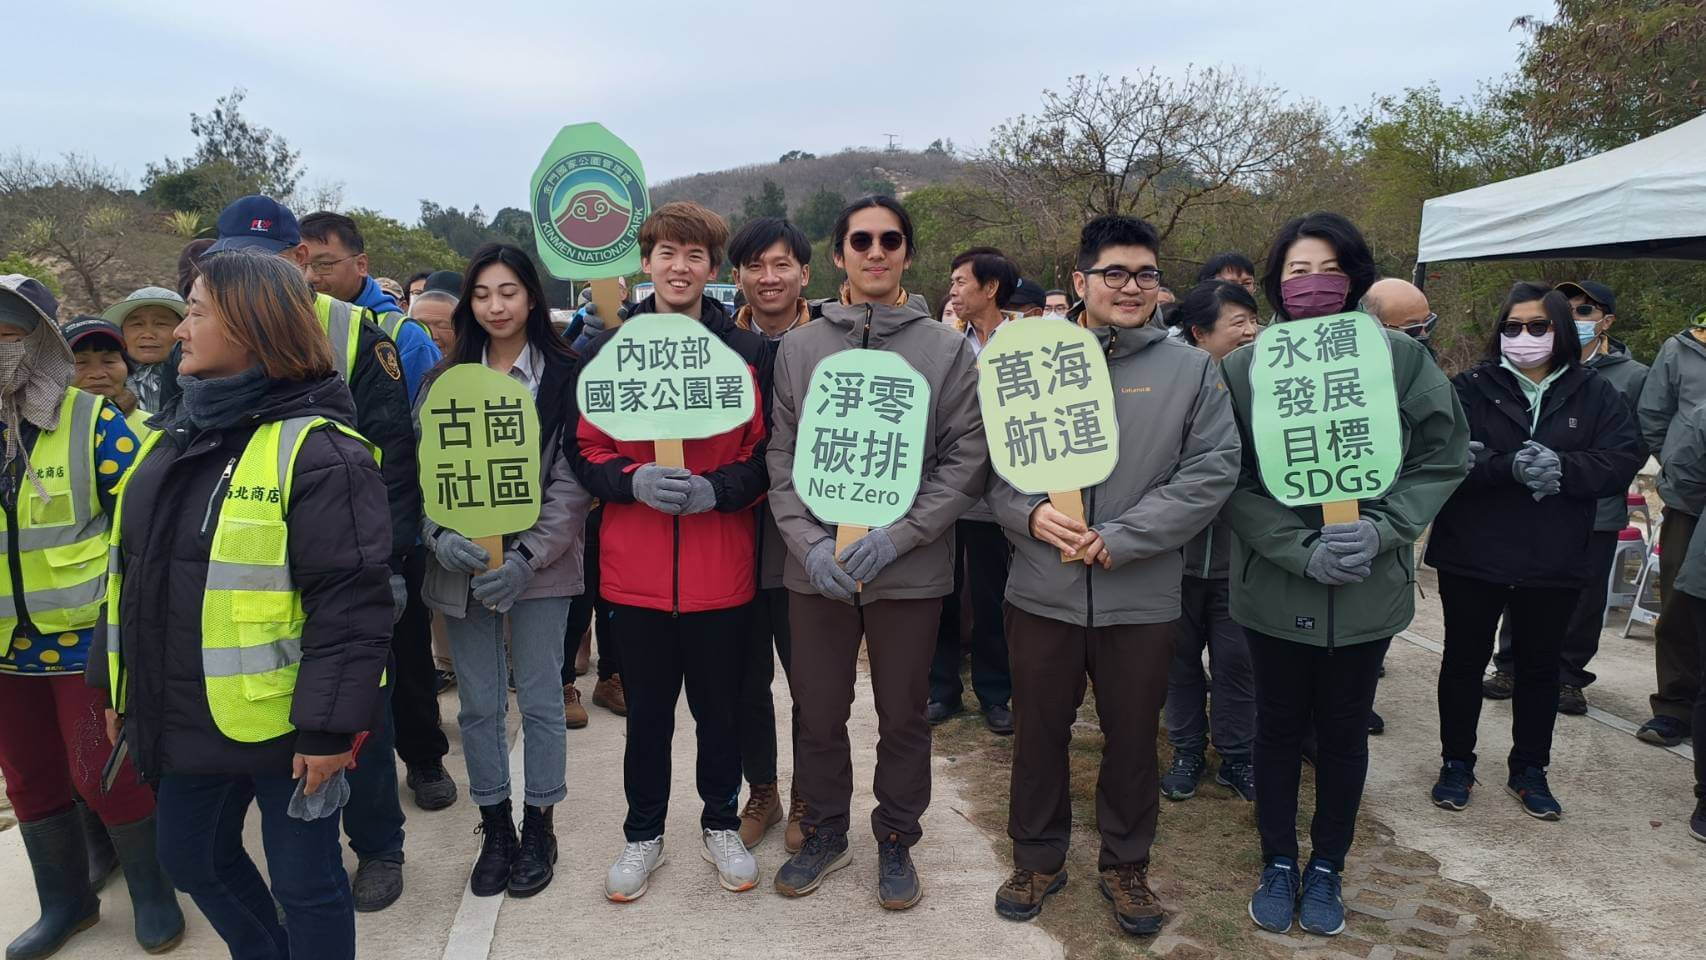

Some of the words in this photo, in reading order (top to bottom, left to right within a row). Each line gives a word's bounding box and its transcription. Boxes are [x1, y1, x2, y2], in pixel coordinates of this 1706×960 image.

[541, 221, 576, 258] KINMEN
[577, 238, 633, 262] NATIONAL
[628, 207, 644, 239] PARK
[616, 336, 711, 372] 內政部
[1267, 318, 1360, 369] 永續
[585, 375, 744, 414] 國家公園署
[816, 370, 915, 425] 淨零
[988, 341, 1092, 407] 萬海
[1272, 367, 1367, 419] 發展
[431, 396, 525, 450] 古崗
[1004, 400, 1108, 467] 航運
[1283, 417, 1374, 467] 目標
[26, 466, 64, 480] 北商店
[810, 427, 909, 480] 碳排
[436, 458, 533, 510] 社區
[808, 477, 846, 500] Net
[850, 482, 900, 506] Zero
[1284, 465, 1382, 499] SDGs
